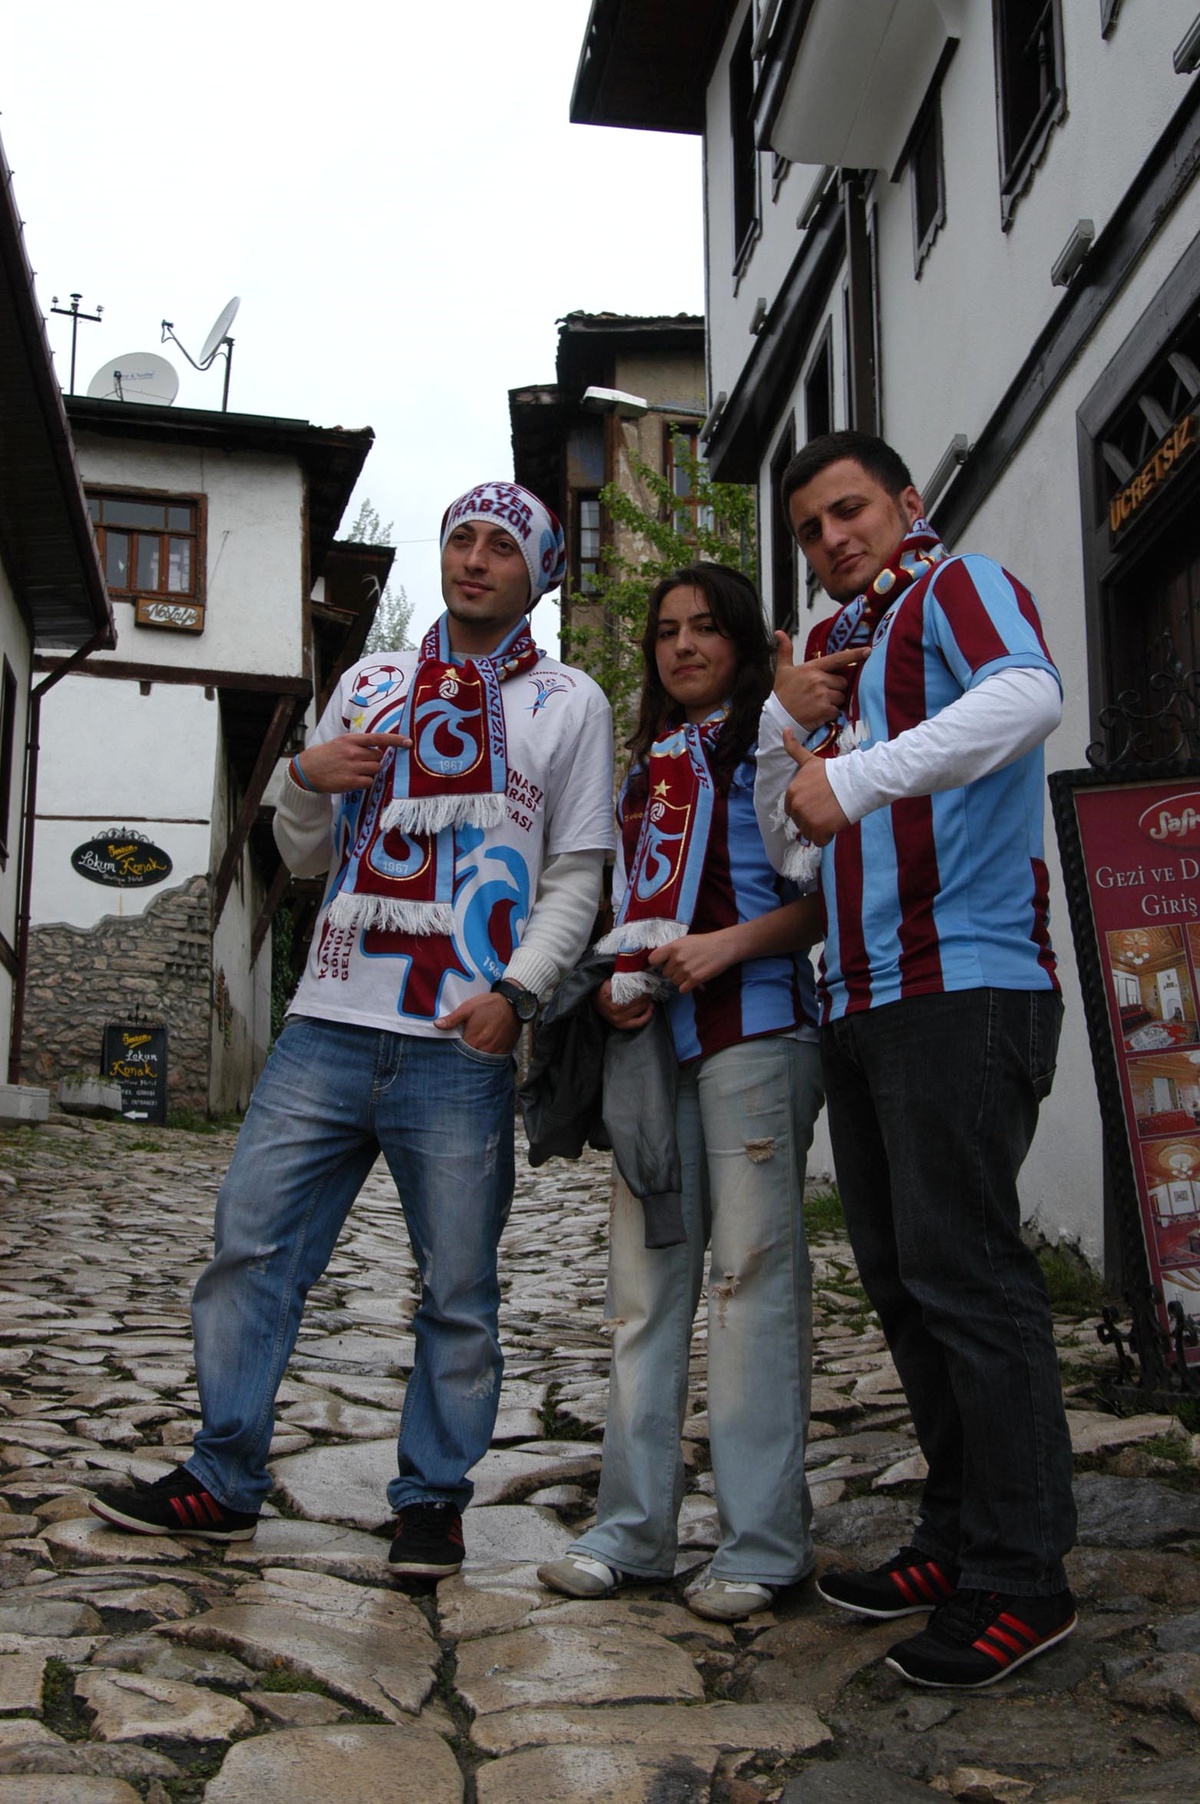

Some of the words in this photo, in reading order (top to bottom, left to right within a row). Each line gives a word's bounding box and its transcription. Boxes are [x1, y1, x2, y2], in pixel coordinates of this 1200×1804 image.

[495, 489, 534, 521] YER
[452, 498, 532, 541] RABZON
[438, 760, 464, 771] 1967
[78, 851, 116, 873] Lokum
[119, 857, 167, 875] Konak
[382, 860, 409, 874] 1967
[318, 927, 337, 979] KARA
[126, 1049, 158, 1062] Lokum
[109, 1060, 158, 1077] Konak
